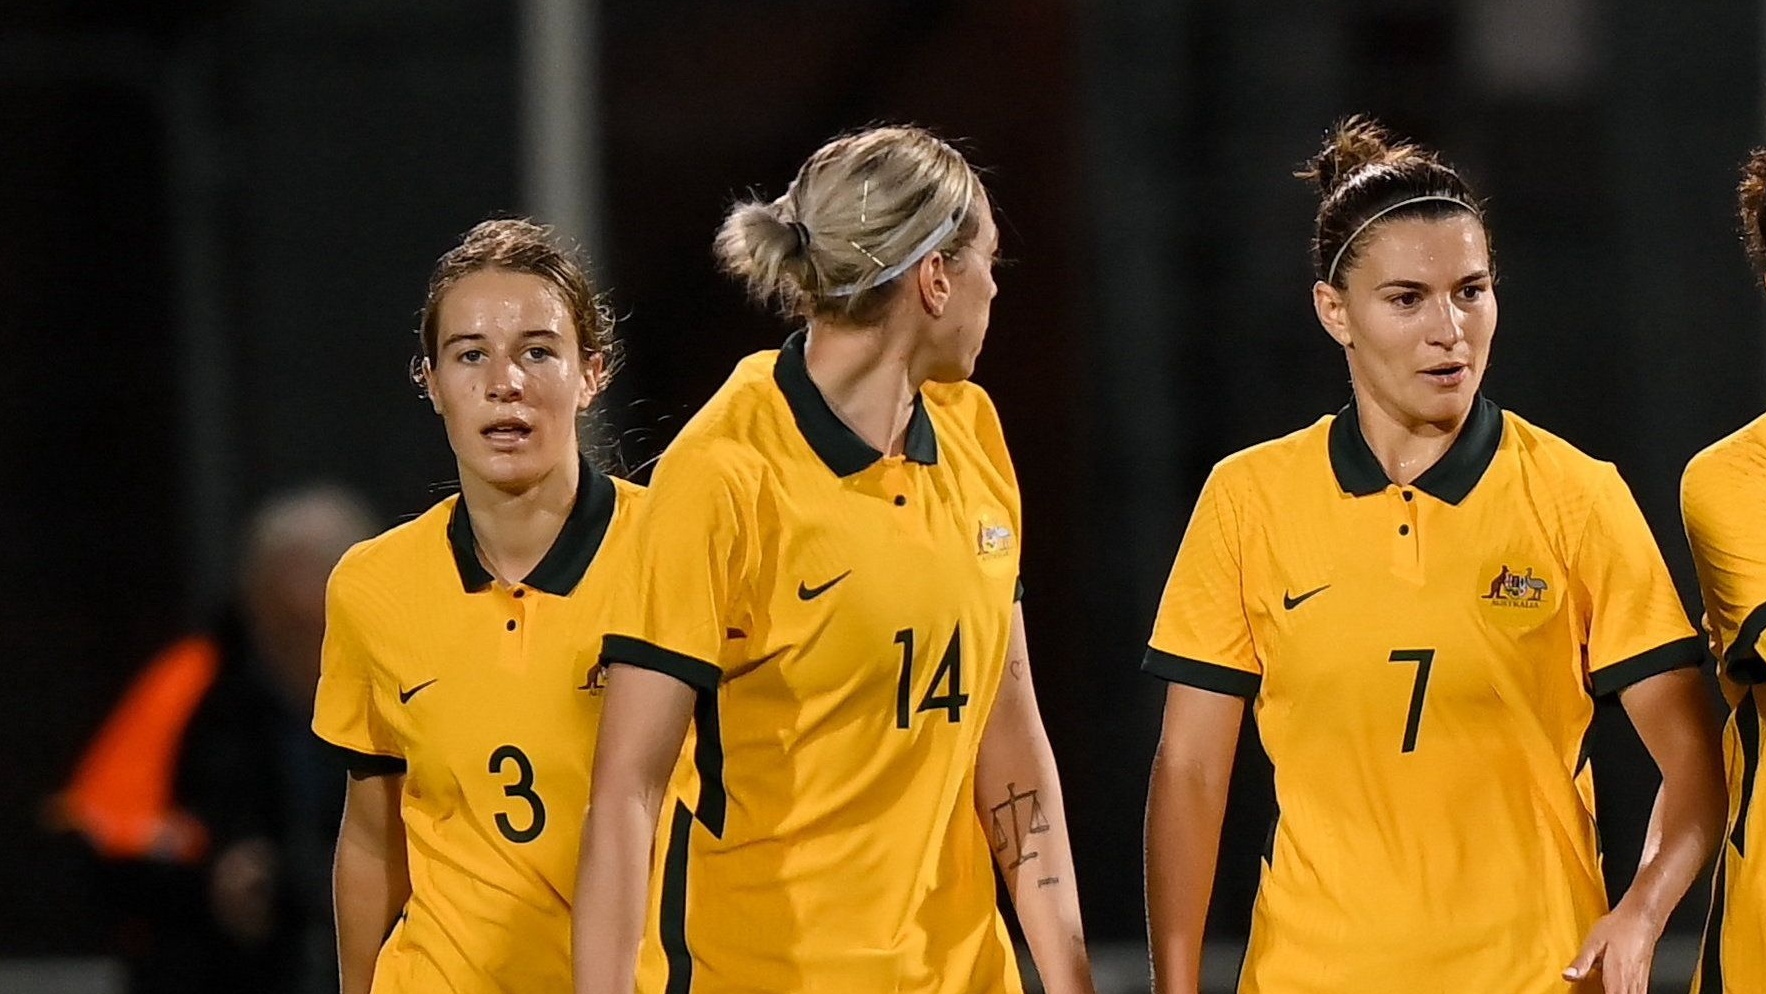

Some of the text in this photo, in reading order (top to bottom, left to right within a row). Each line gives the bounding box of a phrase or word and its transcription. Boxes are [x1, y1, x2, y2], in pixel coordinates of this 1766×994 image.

[893, 620, 970, 729] 14
[1388, 648, 1436, 754] 7
[488, 744, 546, 844] 3
